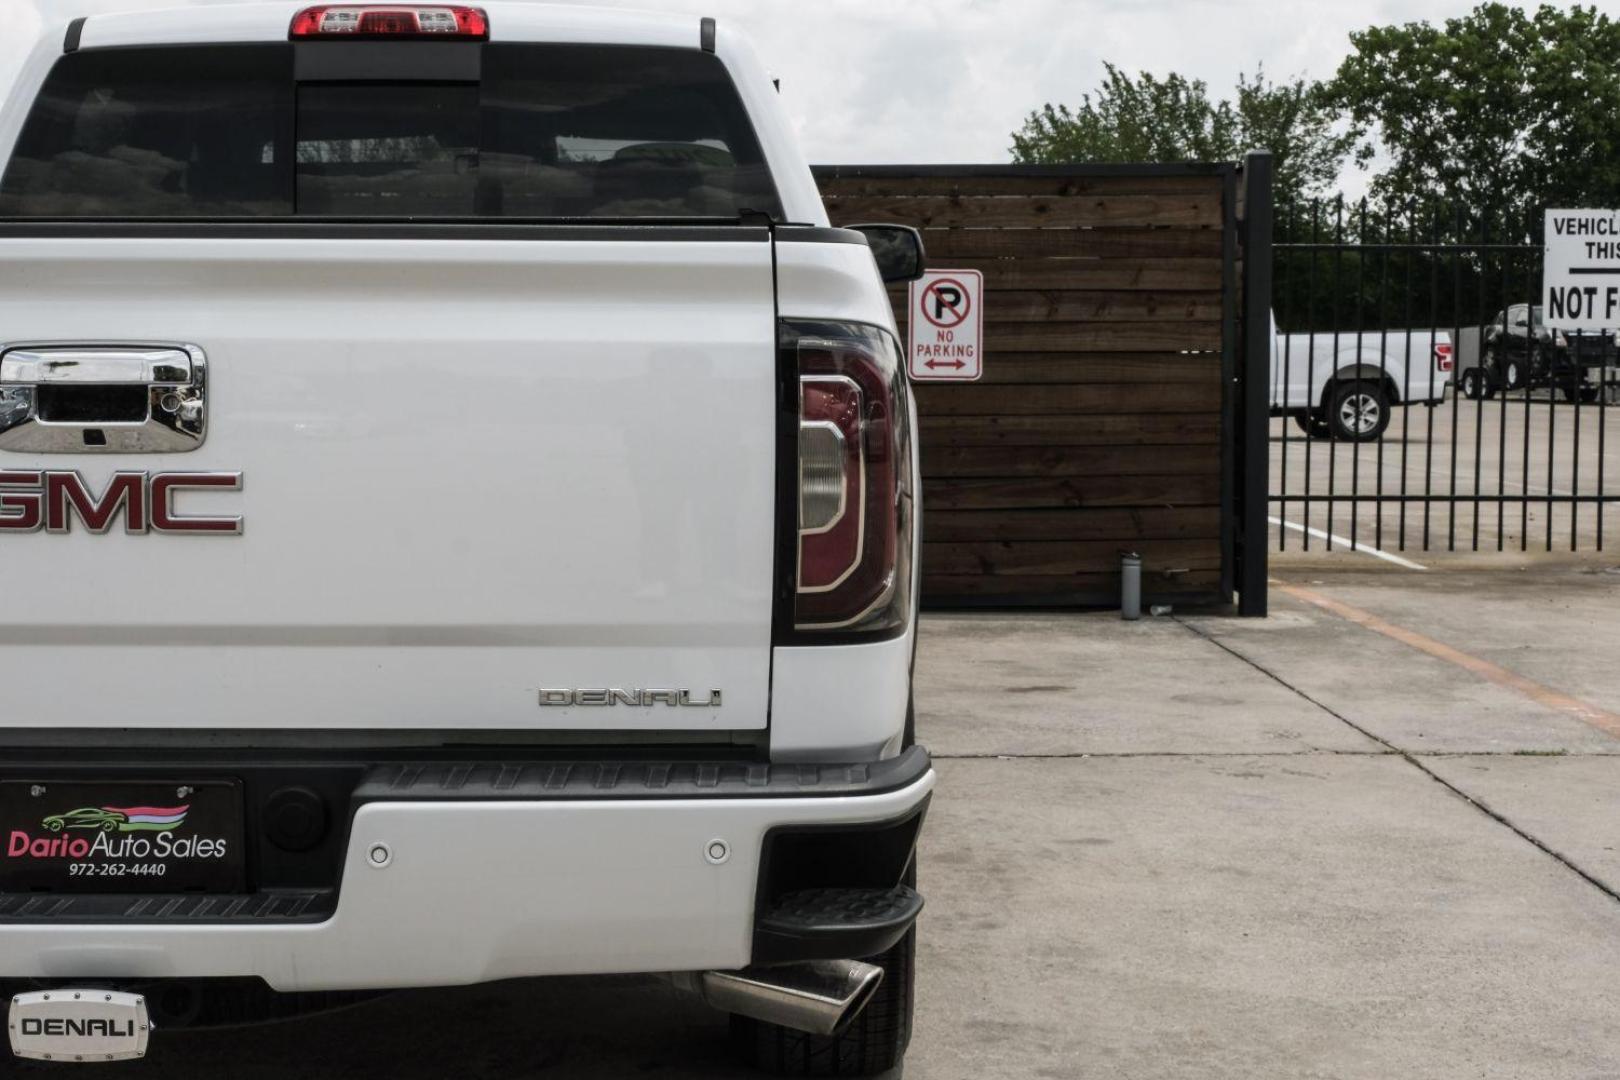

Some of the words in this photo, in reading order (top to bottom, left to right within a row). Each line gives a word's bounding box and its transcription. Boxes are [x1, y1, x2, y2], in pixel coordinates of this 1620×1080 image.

[1553, 217, 1620, 235] VEHICL
[1549, 286, 1598, 320] NOT
[937, 330, 954, 342] NO
[917, 344, 974, 357] PARKING
[539, 688, 722, 706] DENALI
[8, 831, 89, 857] Dario
[88, 831, 150, 858] Auto
[153, 831, 226, 858] Sales
[69, 863, 166, 876] 972-262-4440
[21, 1018, 134, 1036] DENALI
